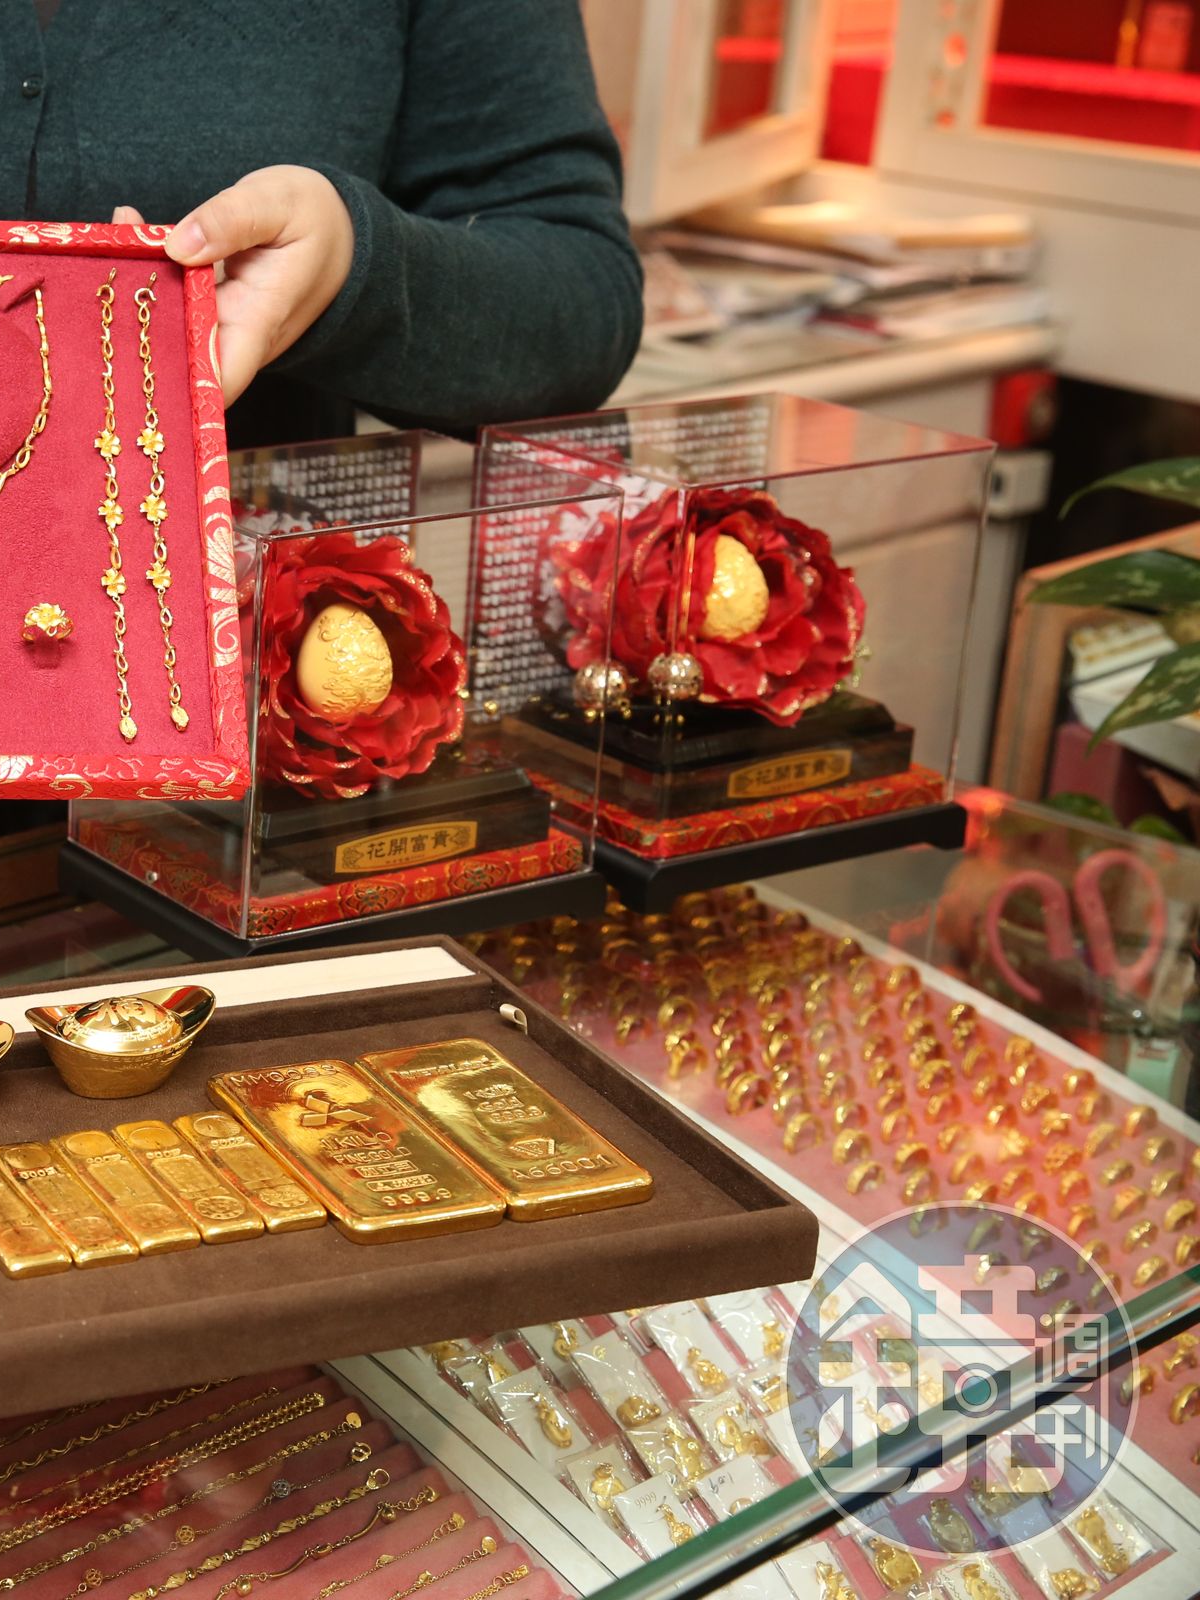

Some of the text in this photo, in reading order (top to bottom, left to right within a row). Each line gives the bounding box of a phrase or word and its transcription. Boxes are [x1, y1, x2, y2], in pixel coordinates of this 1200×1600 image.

[367, 830, 450, 860] 花開富貴
[82, 997, 157, 1026] 福
[476, 1096, 525, 1112] Gold
[511, 1153, 612, 1181] A66001
[382, 1188, 452, 1206] 999.9
